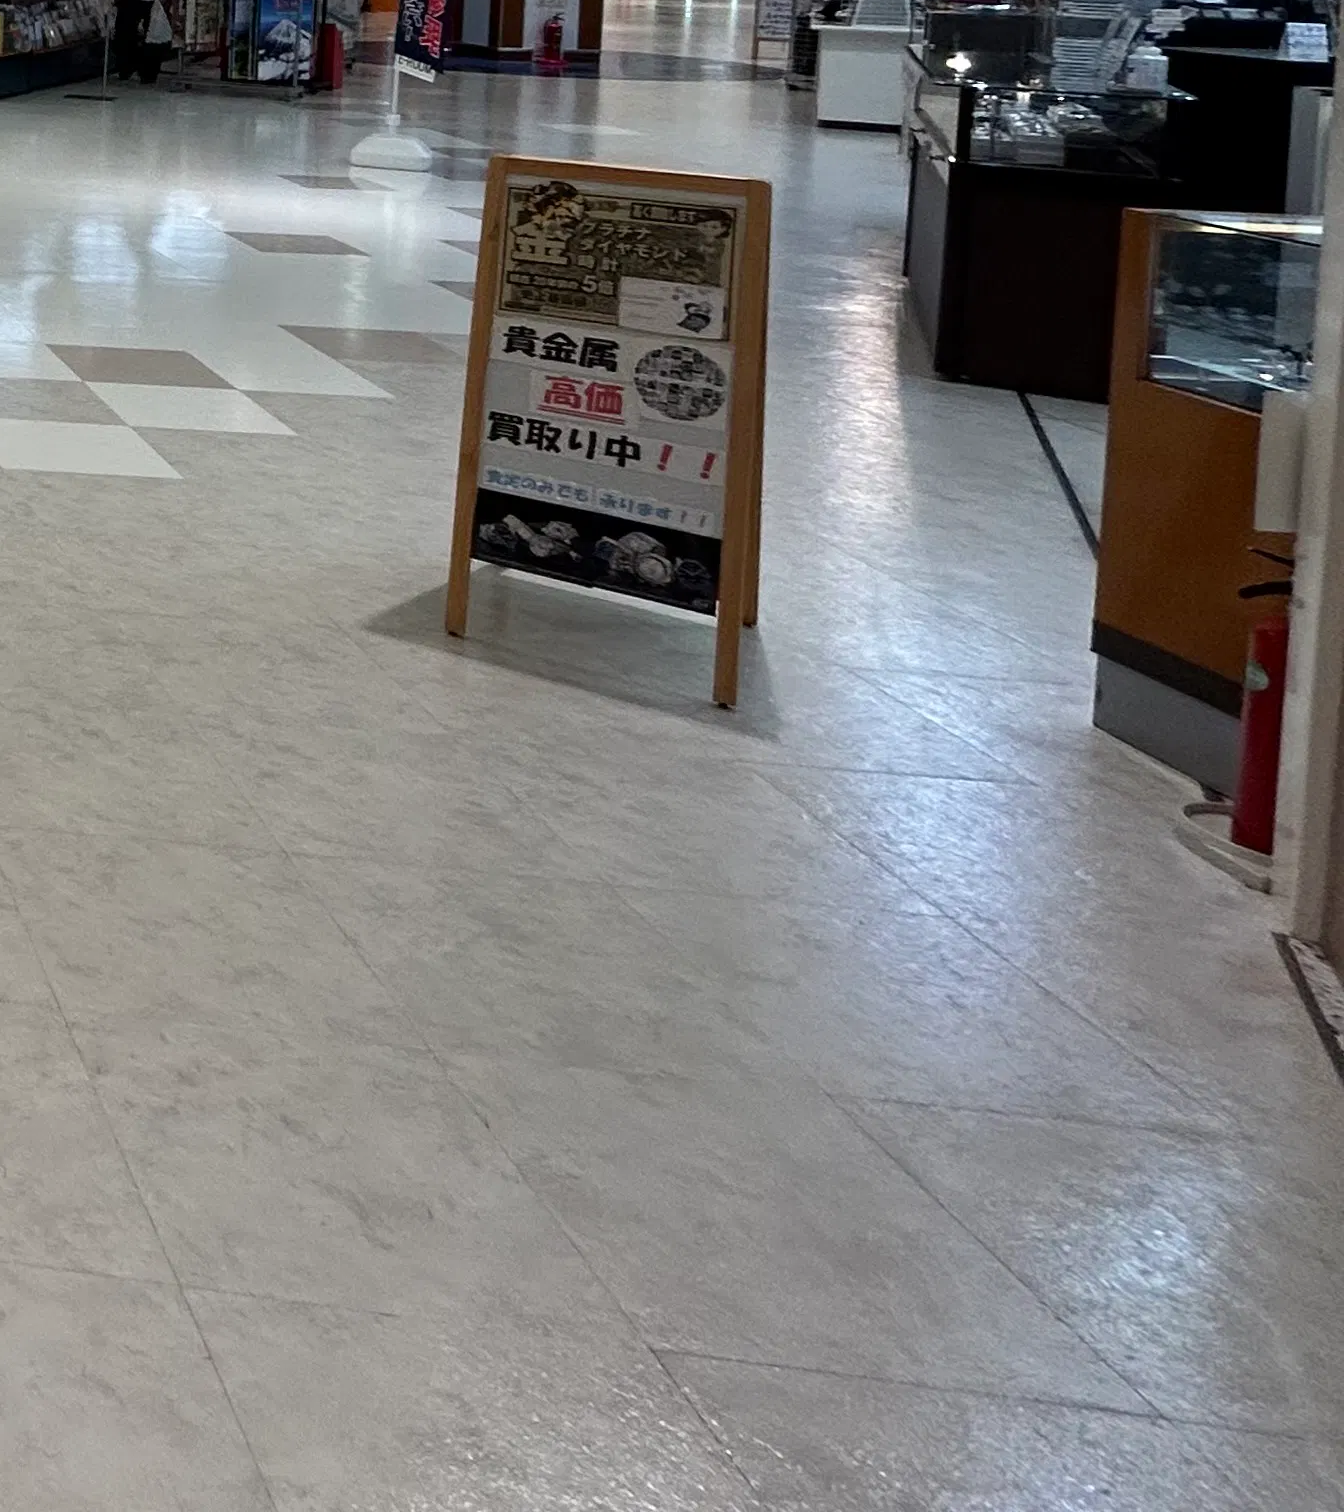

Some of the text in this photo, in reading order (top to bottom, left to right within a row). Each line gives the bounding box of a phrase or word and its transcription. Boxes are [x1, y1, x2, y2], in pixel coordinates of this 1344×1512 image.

[502, 324, 619, 373] 貴金属
[542, 374, 625, 417] 高価
